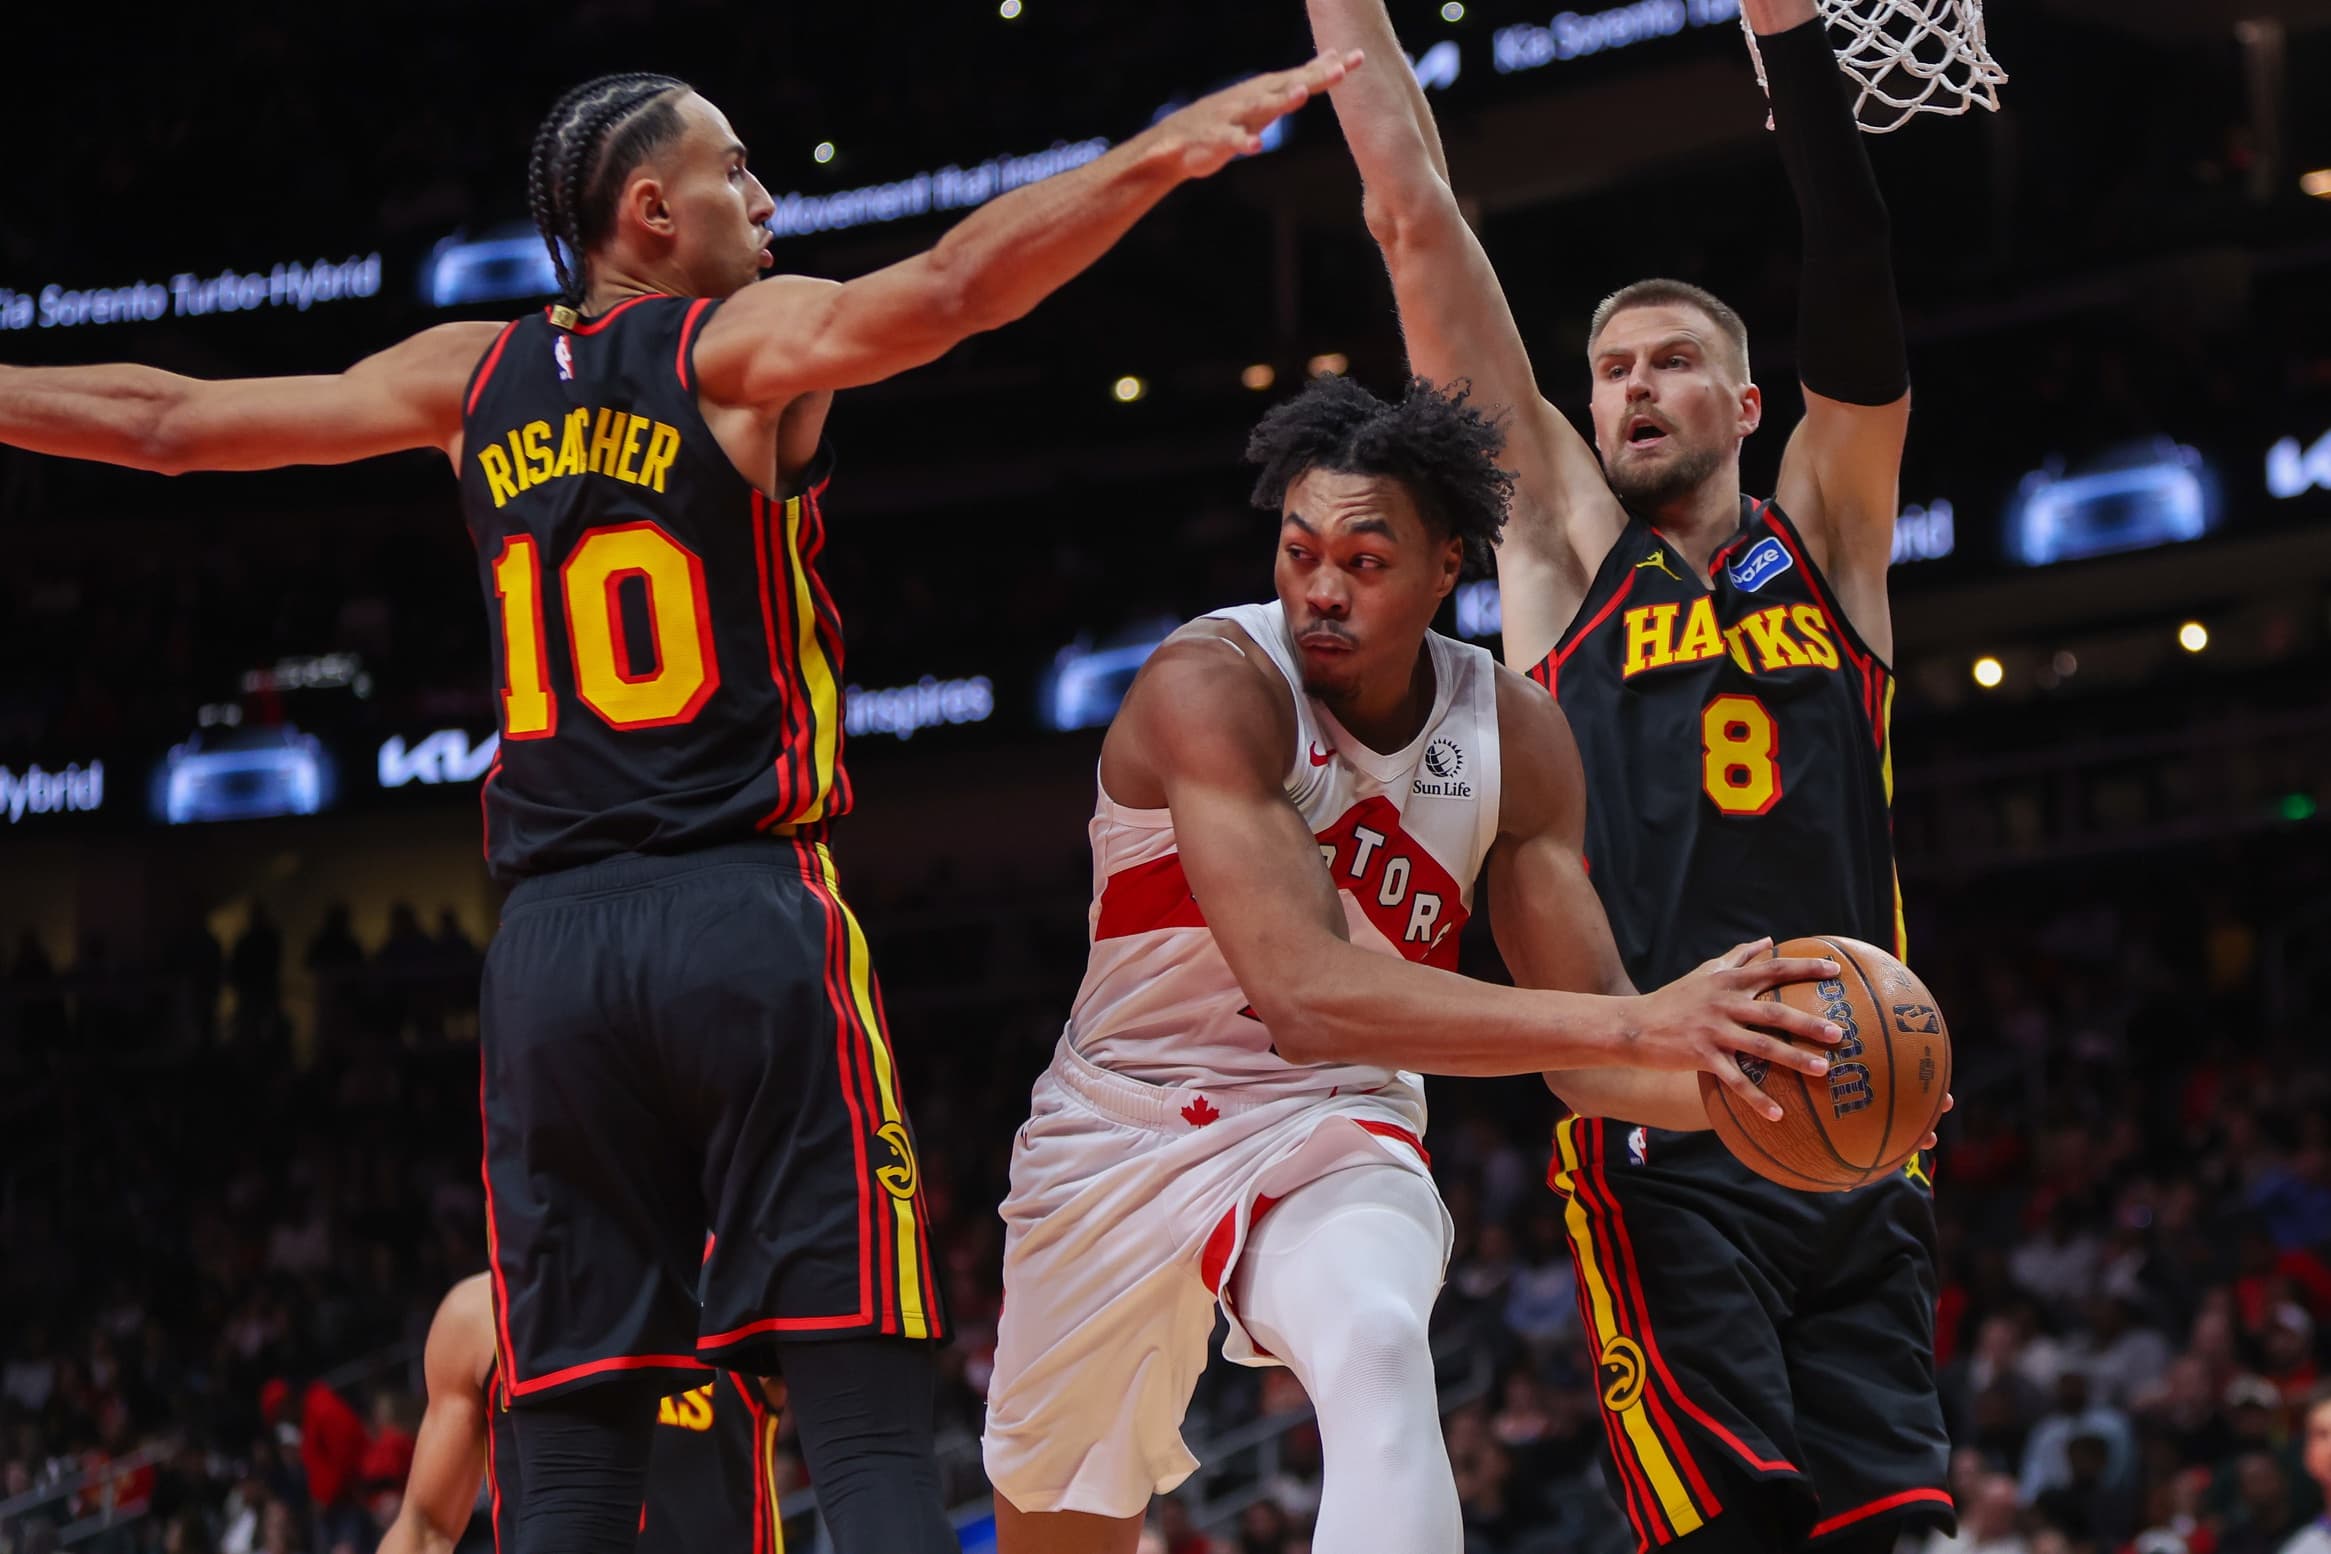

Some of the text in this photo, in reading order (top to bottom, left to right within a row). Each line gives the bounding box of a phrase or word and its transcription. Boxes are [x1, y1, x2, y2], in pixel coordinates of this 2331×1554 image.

[0, 251, 382, 330] ia Sorento Turbo-Hybrid
[492, 520, 721, 741] 10
[0, 758, 104, 824] ybrid
[1412, 780, 1472, 797] Sun Life
[1702, 692, 1784, 816] 8
